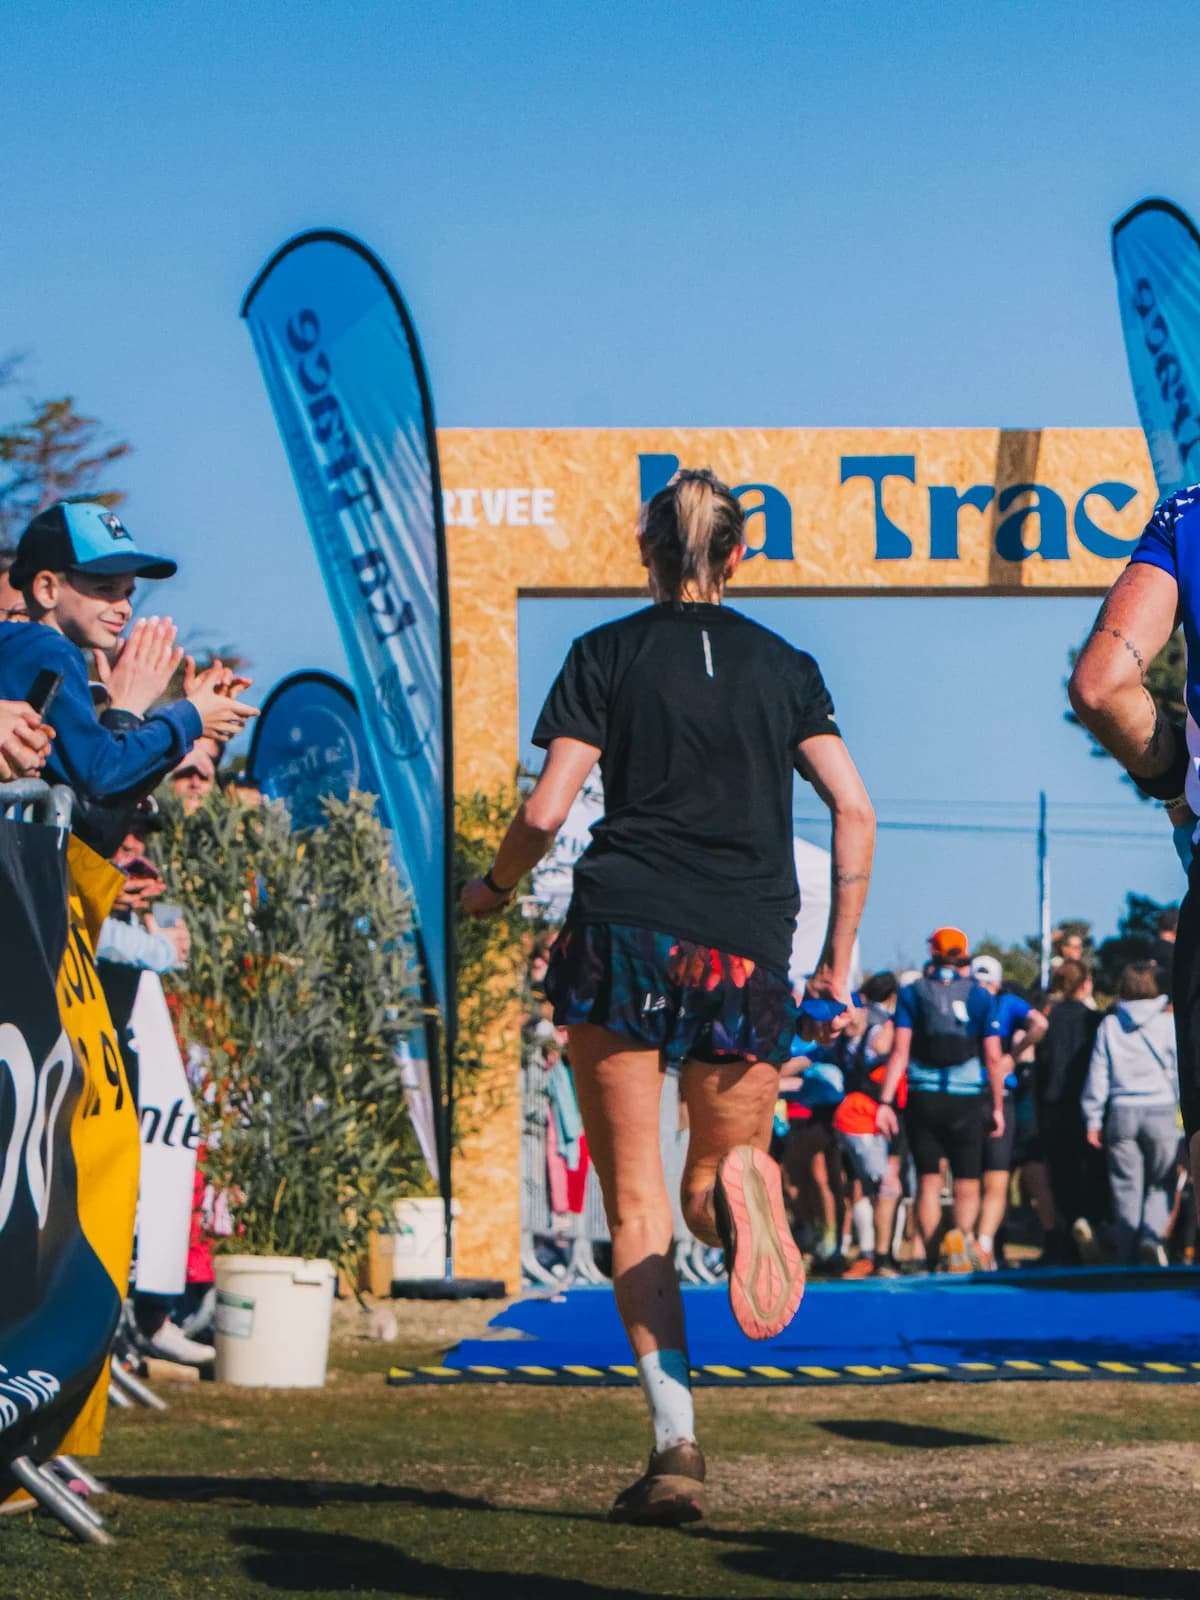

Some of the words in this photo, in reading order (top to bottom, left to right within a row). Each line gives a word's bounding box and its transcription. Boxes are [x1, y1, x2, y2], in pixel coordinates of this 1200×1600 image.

[442, 488, 556, 527] RIVEE
[839, 455, 1143, 563] Trac
[140, 1097, 199, 1151] nte
